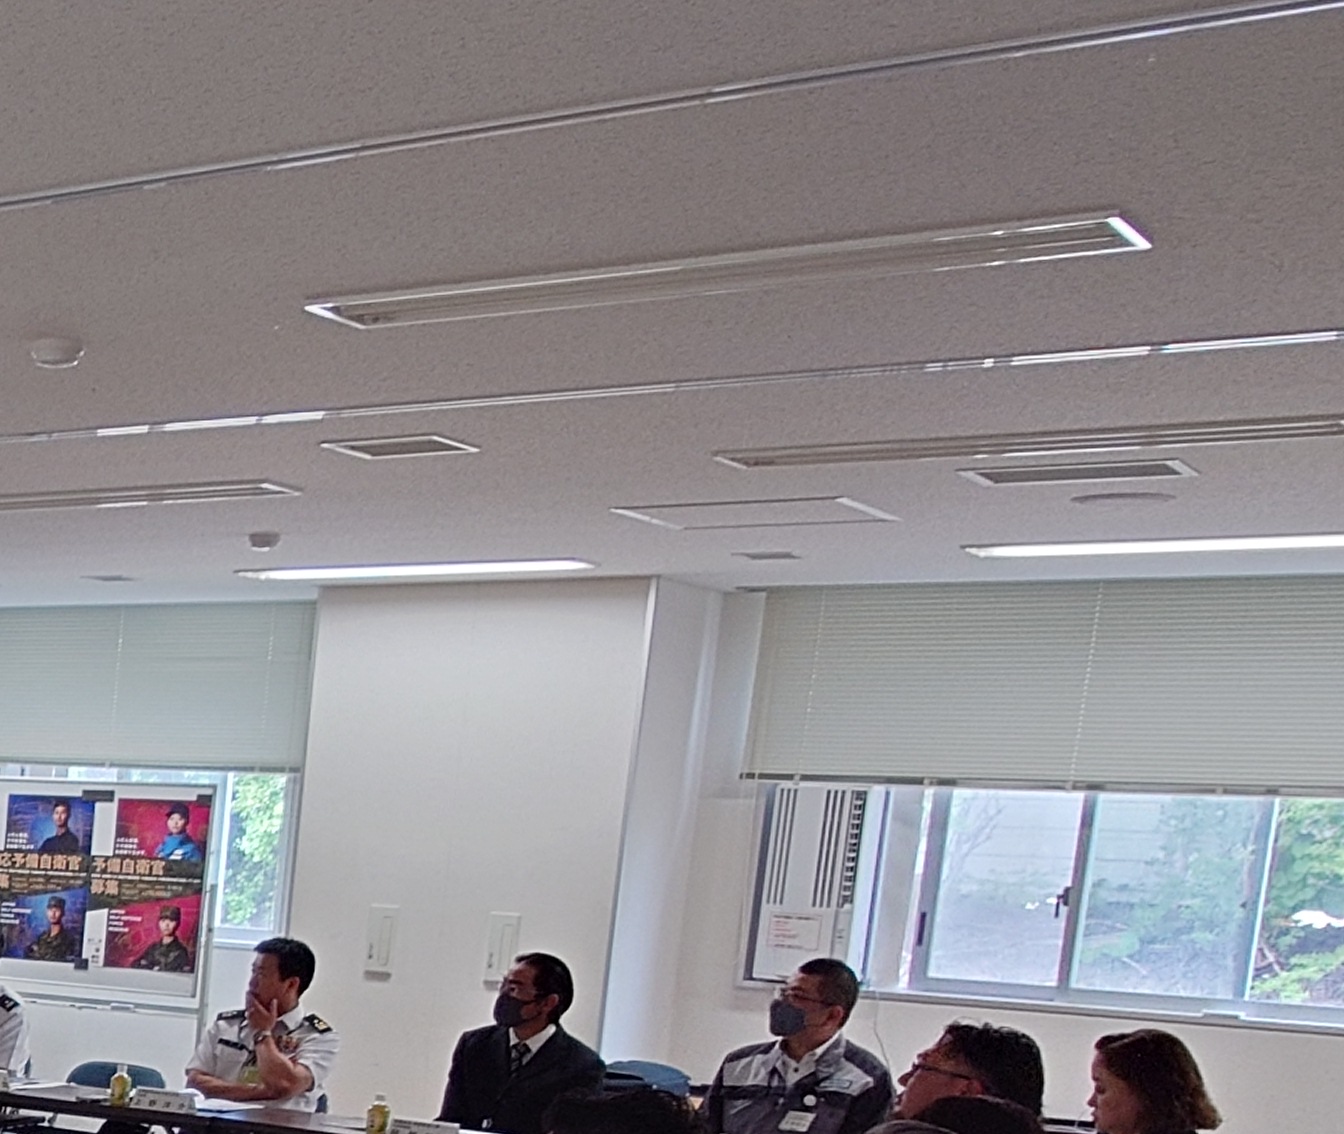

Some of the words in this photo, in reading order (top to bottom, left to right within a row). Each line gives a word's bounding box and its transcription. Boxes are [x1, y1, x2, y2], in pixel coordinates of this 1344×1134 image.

[92, 857, 166, 876] 予備自衛官
